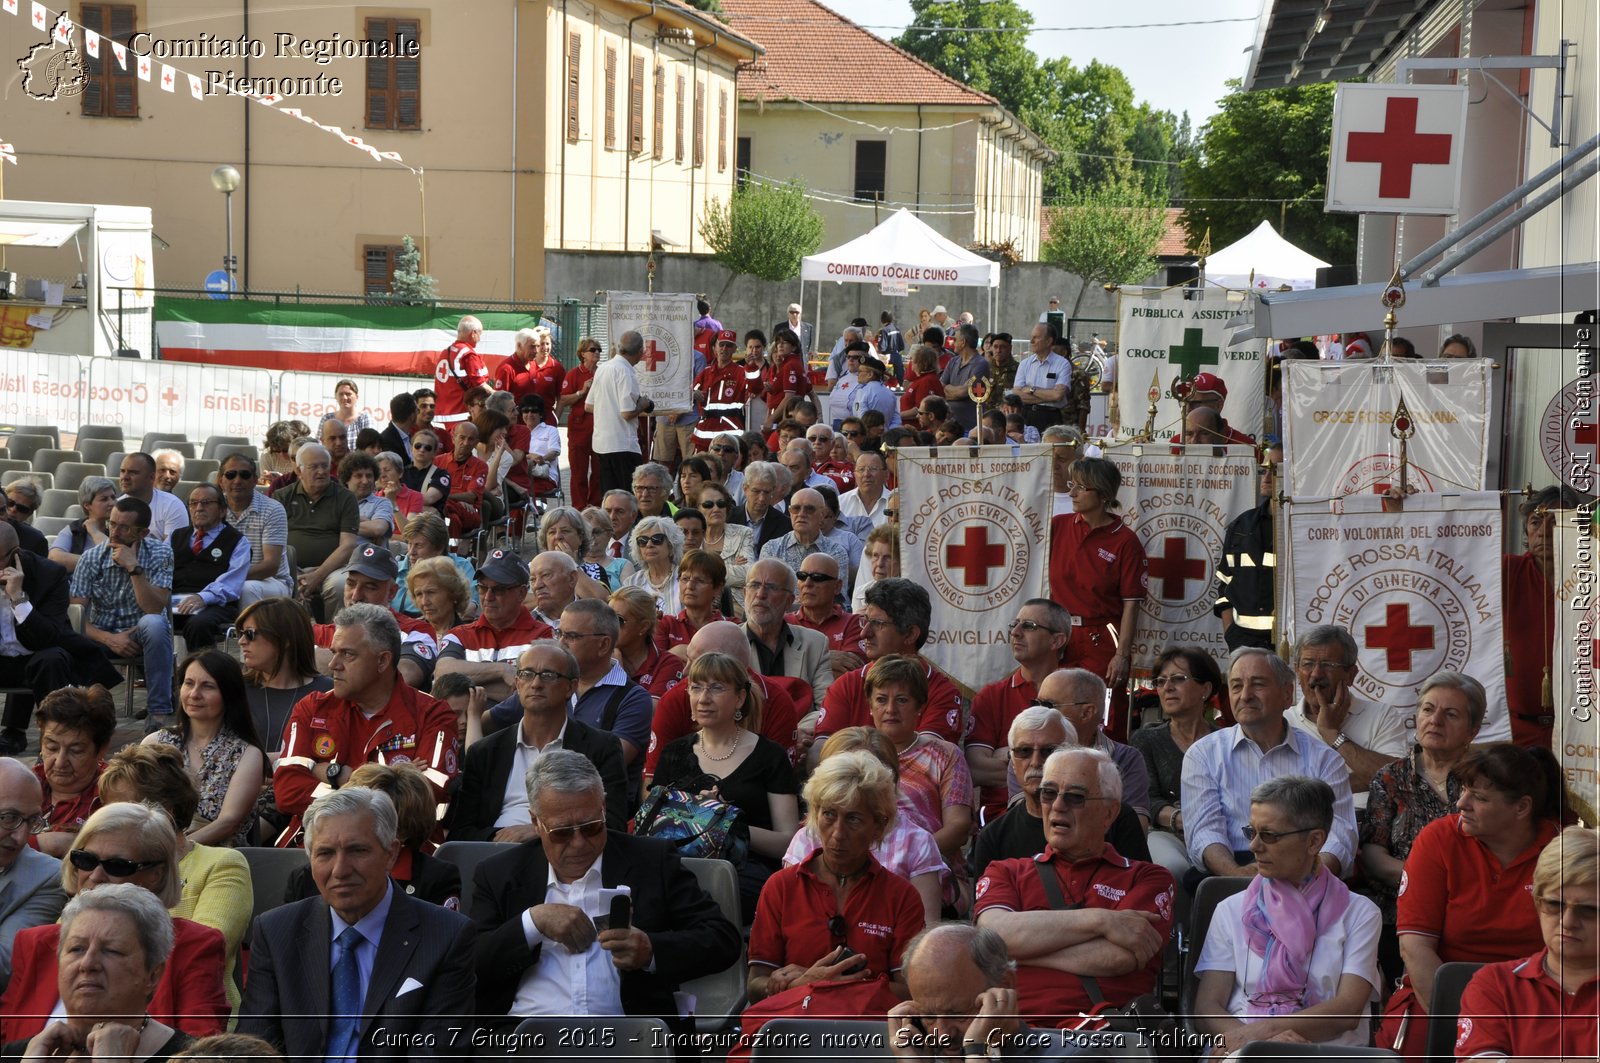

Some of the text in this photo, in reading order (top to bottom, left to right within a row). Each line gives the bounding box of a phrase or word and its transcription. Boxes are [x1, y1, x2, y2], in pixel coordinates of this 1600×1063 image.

[827, 262, 958, 281] COMITATO LOCALE CUNEO
[1131, 307, 1184, 319] PUBBLICA
[1126, 348, 1260, 361] CROCE VERDE
[1312, 410, 1355, 424] CROCE
[921, 462, 1031, 474] VOLONTARI DEL SOCCORSO
[1138, 462, 1184, 475] VOLONTARI
[1187, 464, 1204, 475] DEL
[1208, 464, 1250, 476] SOCCORSO
[1139, 477, 1185, 489] FEMMINILE
[1187, 478, 1193, 489] E
[1196, 478, 1232, 490] PIONIERI
[1139, 492, 1195, 513] ROSSA
[905, 480, 1045, 546] CROCE ROSSA ITALIANA
[1141, 524, 1154, 538] DI
[1158, 516, 1209, 541] GINEVRA
[1308, 523, 1493, 541] CORPO VOLONTARI DEL SOCCORSO
[1207, 538, 1222, 554] 22
[928, 504, 1028, 606] CONVENZIONE DI GINEVRA 22 AGOSTO 1864
[1305, 564, 1350, 624] CROCE
[1348, 543, 1421, 572] ROSSA
[1425, 548, 1494, 625] ITALIANA
[1351, 585, 1369, 602] DI
[1373, 573, 1442, 600] GINEVRA
[1440, 598, 1460, 618] 22
[1185, 598, 1212, 619] 1864
[926, 629, 1013, 645] SAVIGLIAN
[1173, 630, 1224, 643] LOCALE
